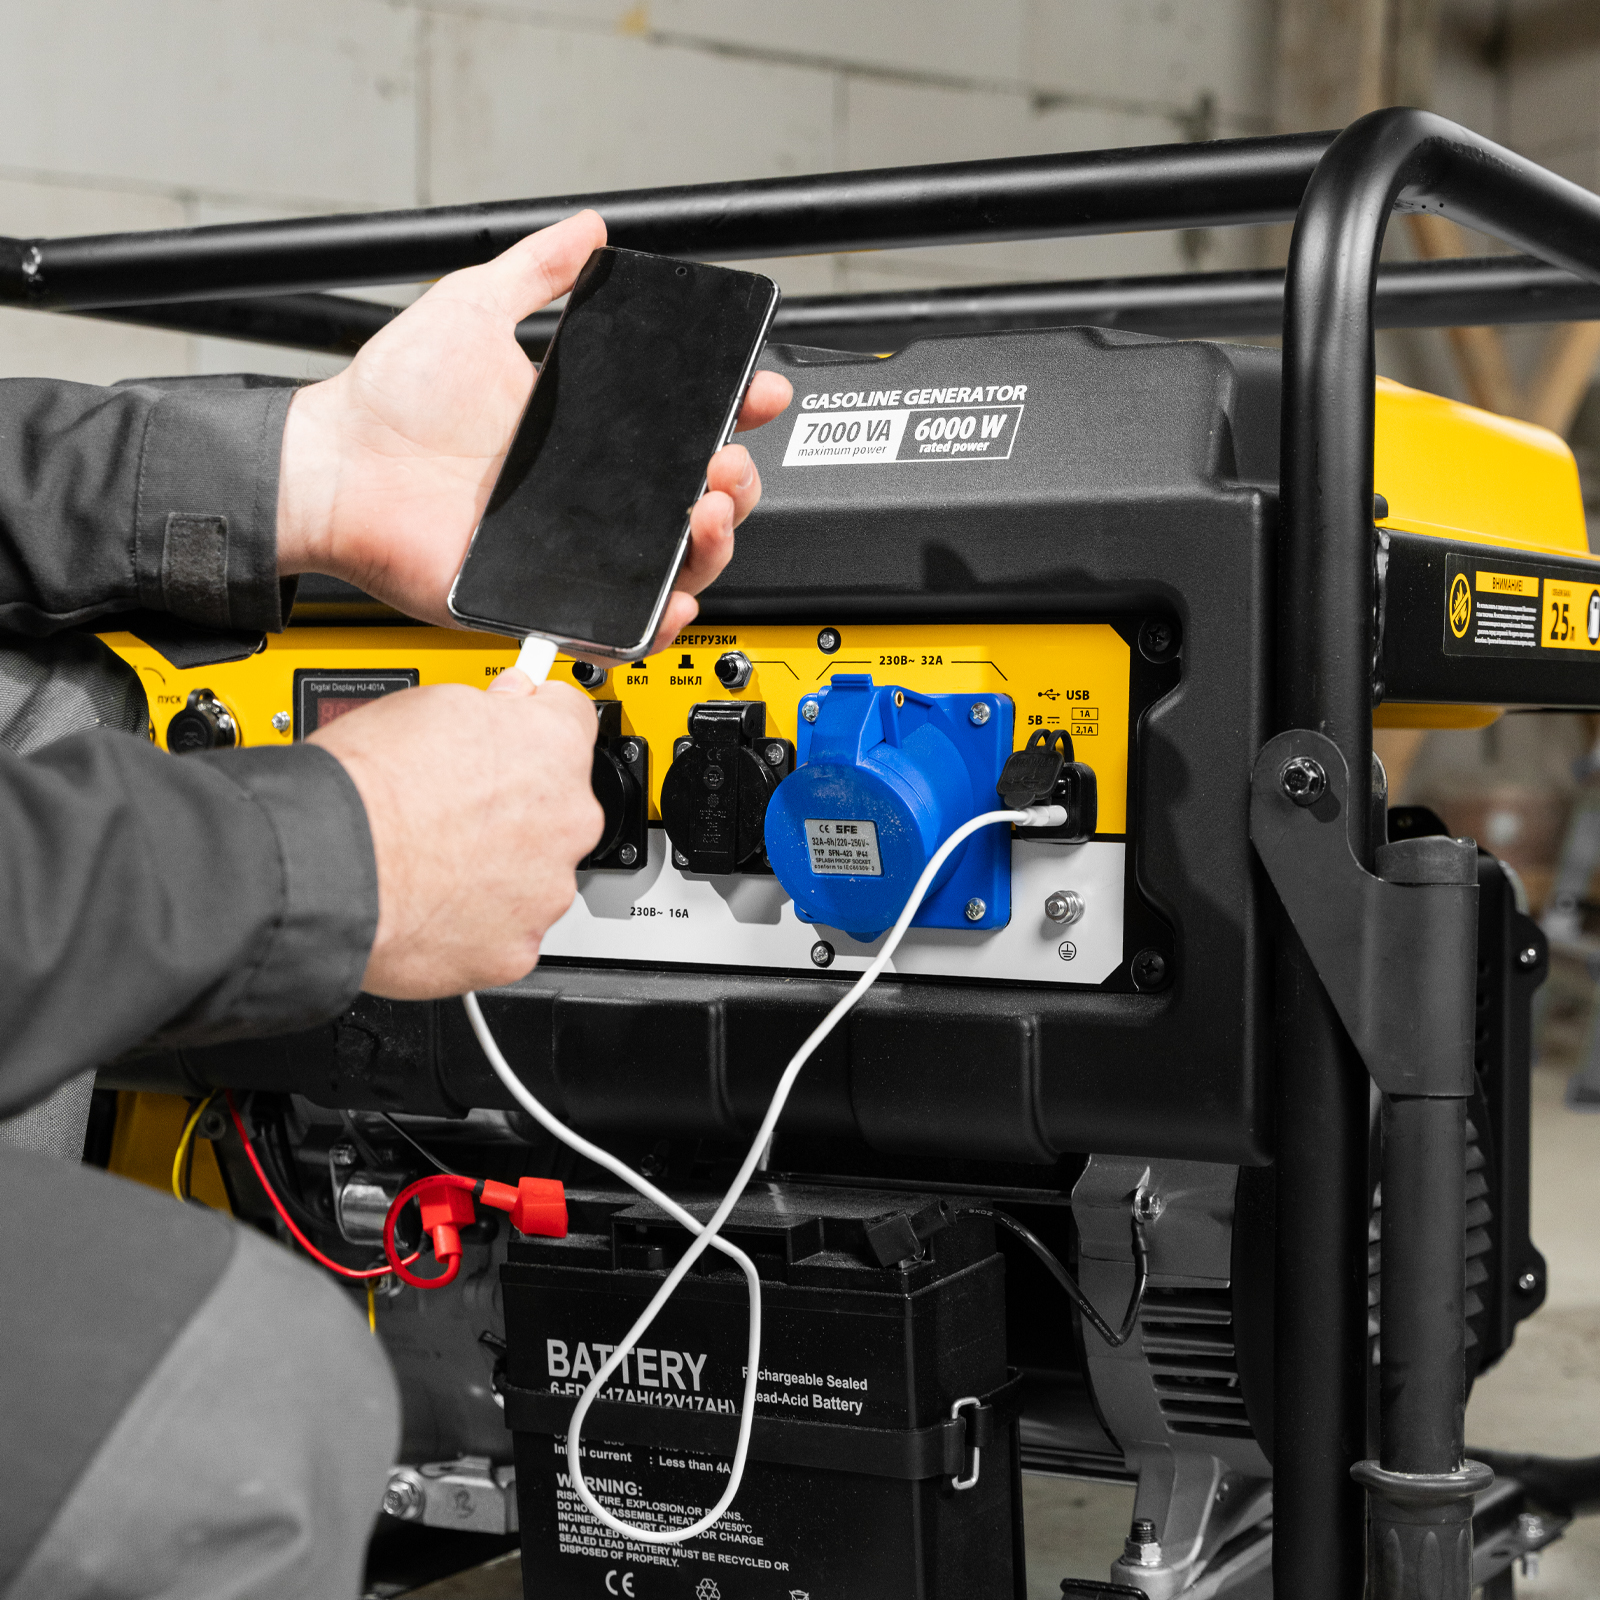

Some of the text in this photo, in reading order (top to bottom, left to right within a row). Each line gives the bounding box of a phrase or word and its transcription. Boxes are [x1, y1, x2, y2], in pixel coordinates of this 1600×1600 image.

[802, 384, 1028, 409] GASOLINE GENERATOR
[803, 419, 892, 444] 7000 VA
[914, 414, 1008, 441] 6000 W
[797, 445, 888, 457] maximum power
[919, 439, 990, 454] rated power
[1550, 602, 1569, 641] 25
[310, 682, 386, 693] Digital Display HJ-401A
[626, 675, 649, 686] ВКЛ
[670, 676, 702, 686] ВЫКЛ
[157, 695, 182, 704] ПУСК
[1066, 690, 1090, 701] USB
[836, 825, 857, 834] SFE
[546, 1338, 708, 1392] BATTERY
[742, 1366, 868, 1391] Rchargeable Sealed
[754, 1391, 863, 1416] ead-Acid Battery
[554, 1443, 586, 1458] Inial
[589, 1448, 632, 1462] current
[659, 1455, 686, 1469] Less
[688, 1459, 714, 1472] than
[556, 1472, 643, 1497] WRNING:
[557, 1489, 580, 1501] RISK
[598, 1495, 624, 1508] FIRE,
[626, 1498, 702, 1516] EXPLOSION,OR
[705, 1508, 744, 1521] BRNS.
[557, 1501, 753, 1534] DO NO SASSEMBLE, HEAT OVE50°C
[559, 1523, 620, 1539] IN A SEALED
[659, 1524, 717, 1540] CIR,OR
[719, 1532, 764, 1546] CHARGE
[559, 1533, 597, 1546] SEALED
[598, 1538, 625, 1550] LEAD
[626, 1541, 670, 1556] BATTERY
[672, 1548, 699, 1560] MUST
[702, 1551, 716, 1562] BE
[718, 1553, 772, 1569] RECYCLED
[774, 1561, 790, 1572] OR
[560, 1543, 680, 1567] DISPOSED OF PROPERLY.
